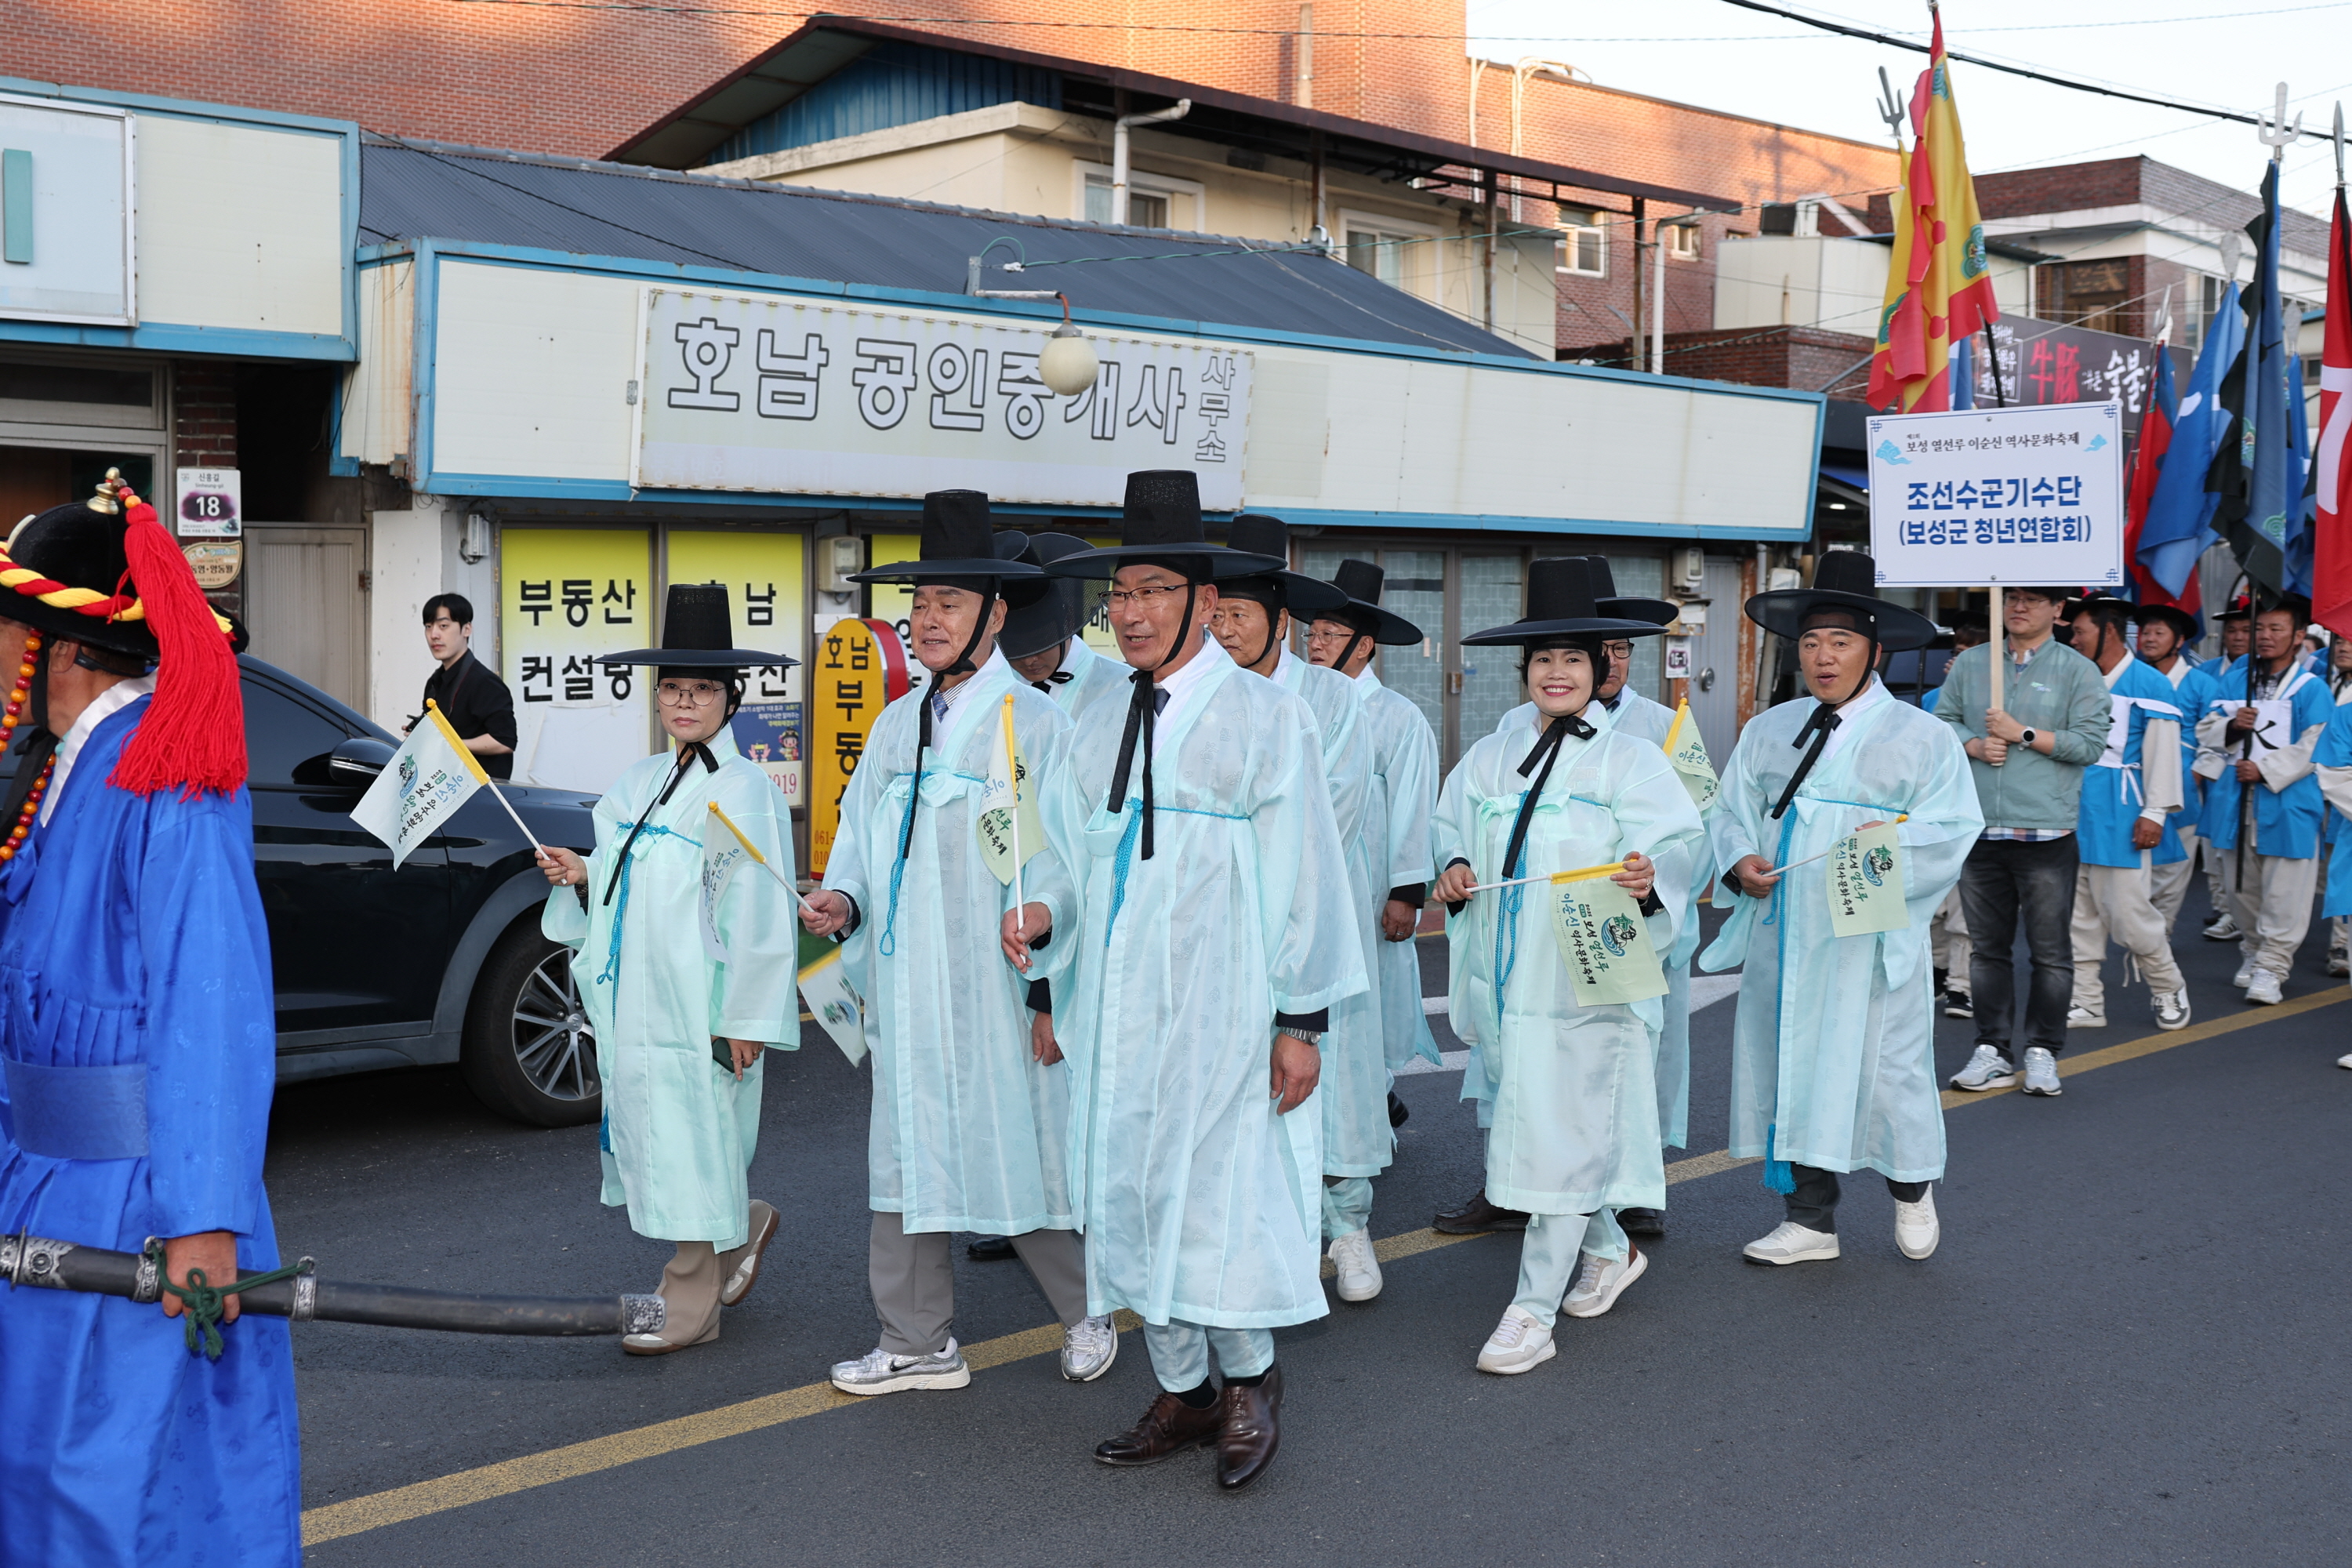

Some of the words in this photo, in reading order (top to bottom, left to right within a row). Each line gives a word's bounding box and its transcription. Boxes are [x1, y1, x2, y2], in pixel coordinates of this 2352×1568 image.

[668, 317, 829, 420] 호남
[851, 337, 1187, 445] 공인중개사
[1196, 356, 1236, 463] 사무소
[1906, 439, 1928, 453] 보성
[1931, 438, 1966, 452] 열선루
[1968, 435, 2002, 451] 이순신
[2005, 431, 2080, 449] 역사문화축제
[198, 473, 220, 482] 신흥길
[1907, 475, 2082, 510] 조선수군기수단
[196, 495, 220, 517] 18
[1899, 518, 1968, 546] (보성군
[1974, 515, 2092, 545] 청년연합회)
[520, 579, 636, 627] 부동산
[825, 635, 871, 670] 호남
[835, 680, 863, 824] 부동
[1678, 750, 1706, 765] 이순신
[990, 808, 1012, 831] 선루
[1835, 837, 1848, 860] 순신
[1849, 852, 1859, 869] 보성
[1836, 862, 1856, 916] 역사문화축제
[1850, 871, 1868, 902] 열선루
[1584, 903, 1593, 917] 2025
[1560, 893, 1580, 927] 이순신
[1570, 930, 1597, 985] 역사문화축제
[1583, 920, 1597, 938] 보성
[1588, 940, 1610, 973] 열선루
